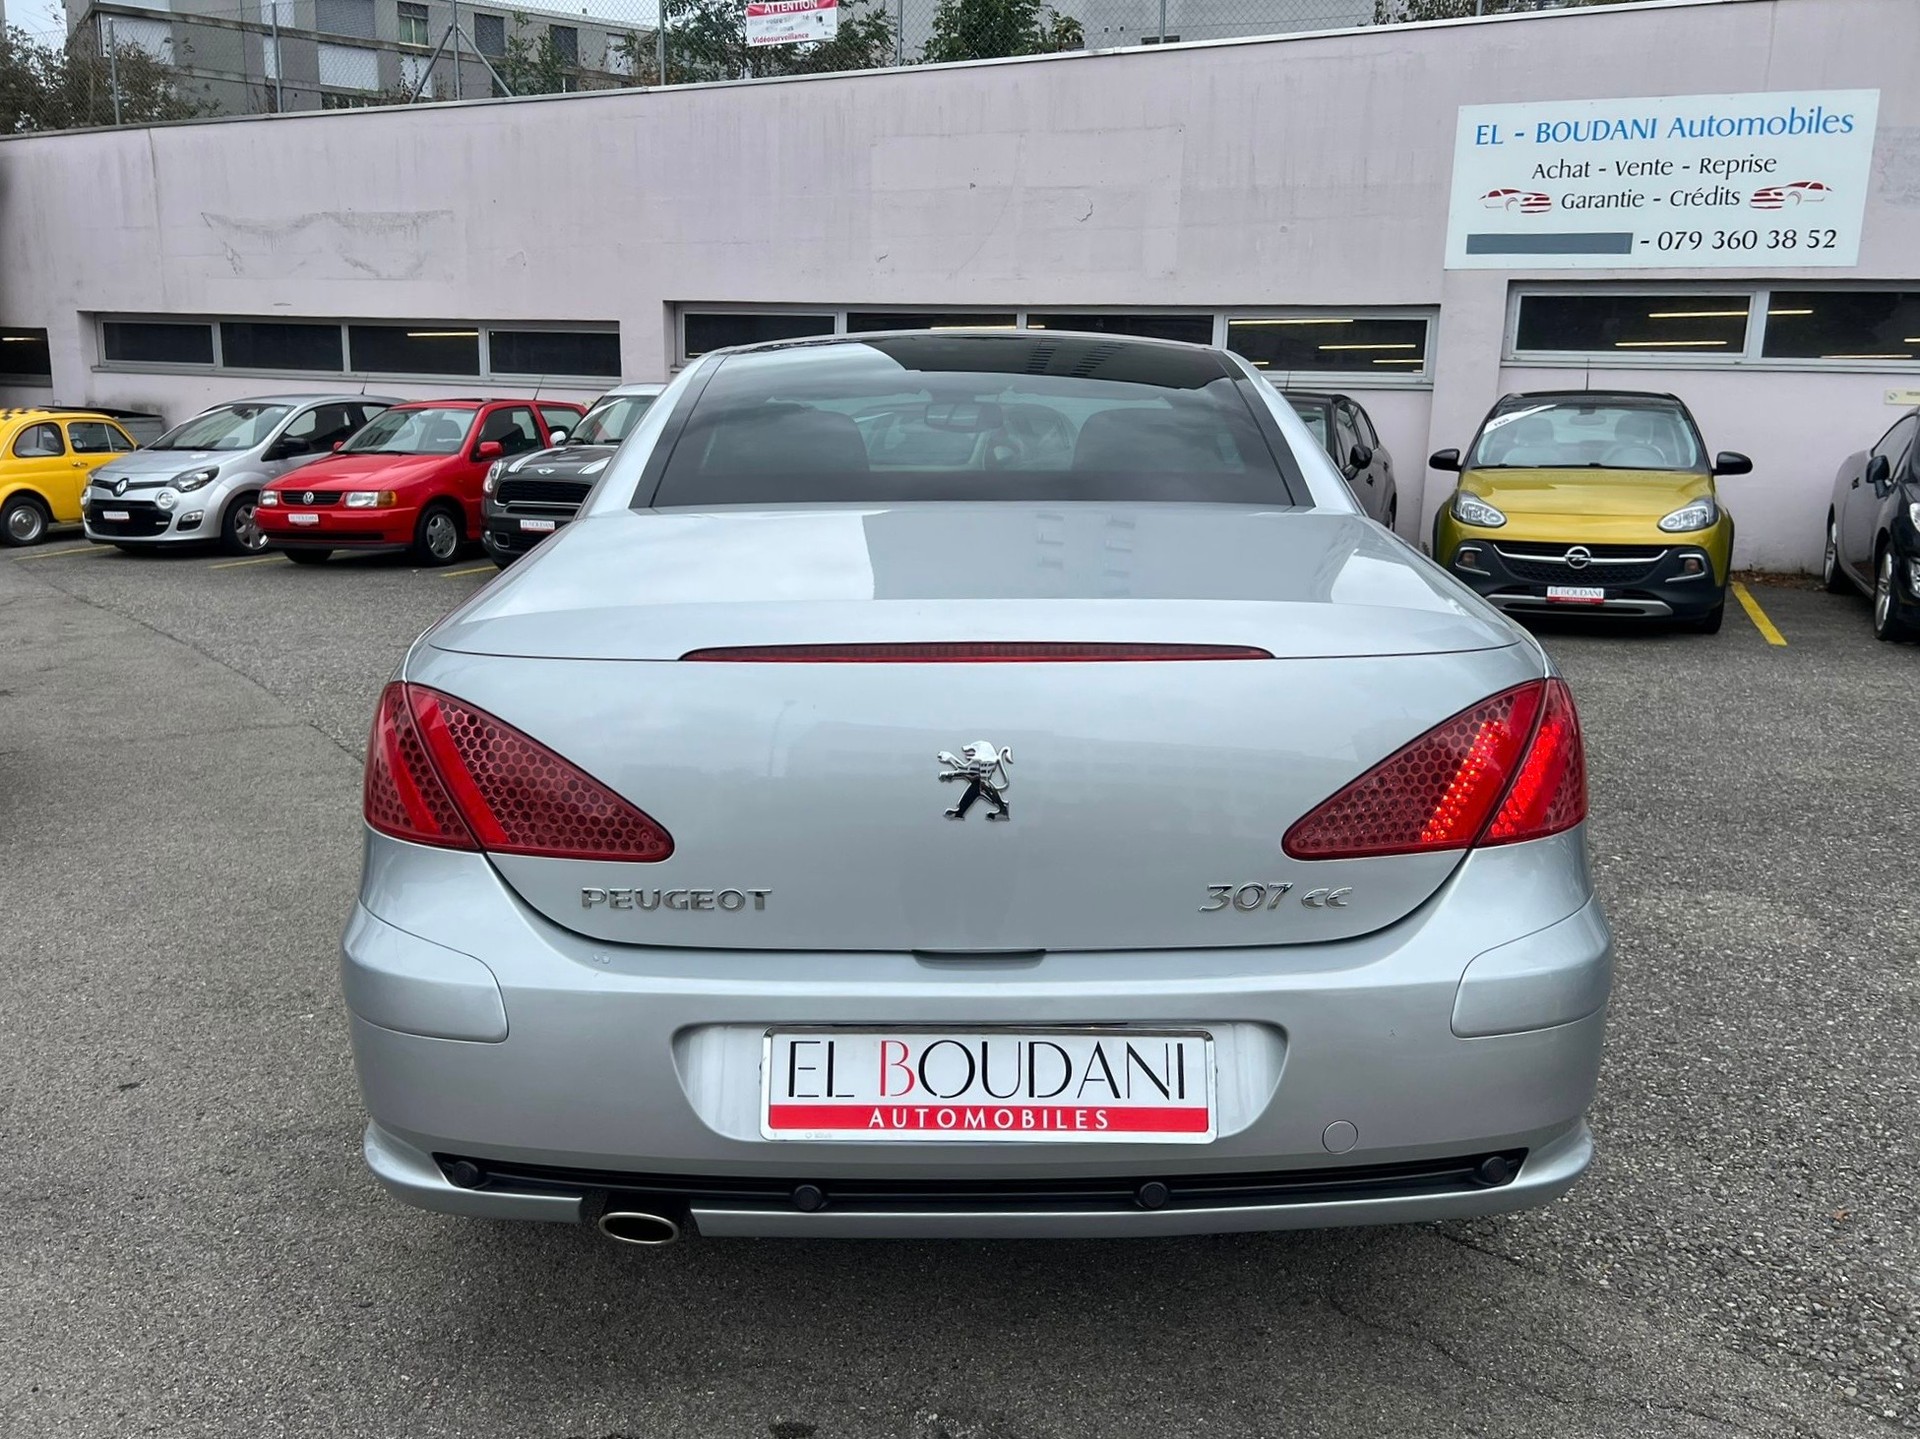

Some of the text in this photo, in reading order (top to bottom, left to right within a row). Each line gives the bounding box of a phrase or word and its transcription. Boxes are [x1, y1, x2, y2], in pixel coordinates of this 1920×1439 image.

[764, 0, 818, 14] ATTENTION
[1475, 124, 1504, 145] EL
[1535, 118, 1658, 143] BOUDANI
[1667, 106, 1854, 139] Automobiles
[1531, 159, 1591, 179] Achat
[1614, 159, 1674, 177] Vente
[1699, 154, 1777, 180] Reprise
[1561, 189, 1645, 210] Garantie
[1670, 185, 1741, 207] Crédits
[1657, 231, 1703, 251] 079
[1711, 230, 1759, 250] 360
[1766, 229, 1798, 249] 38
[1806, 229, 1838, 249] 52
[581, 887, 772, 912] PEUGEOT
[1198, 882, 1293, 912] 307
[787, 1039, 1185, 1100] EL BOUDANI
[868, 1108, 1109, 1130] AUTOMOBILES
